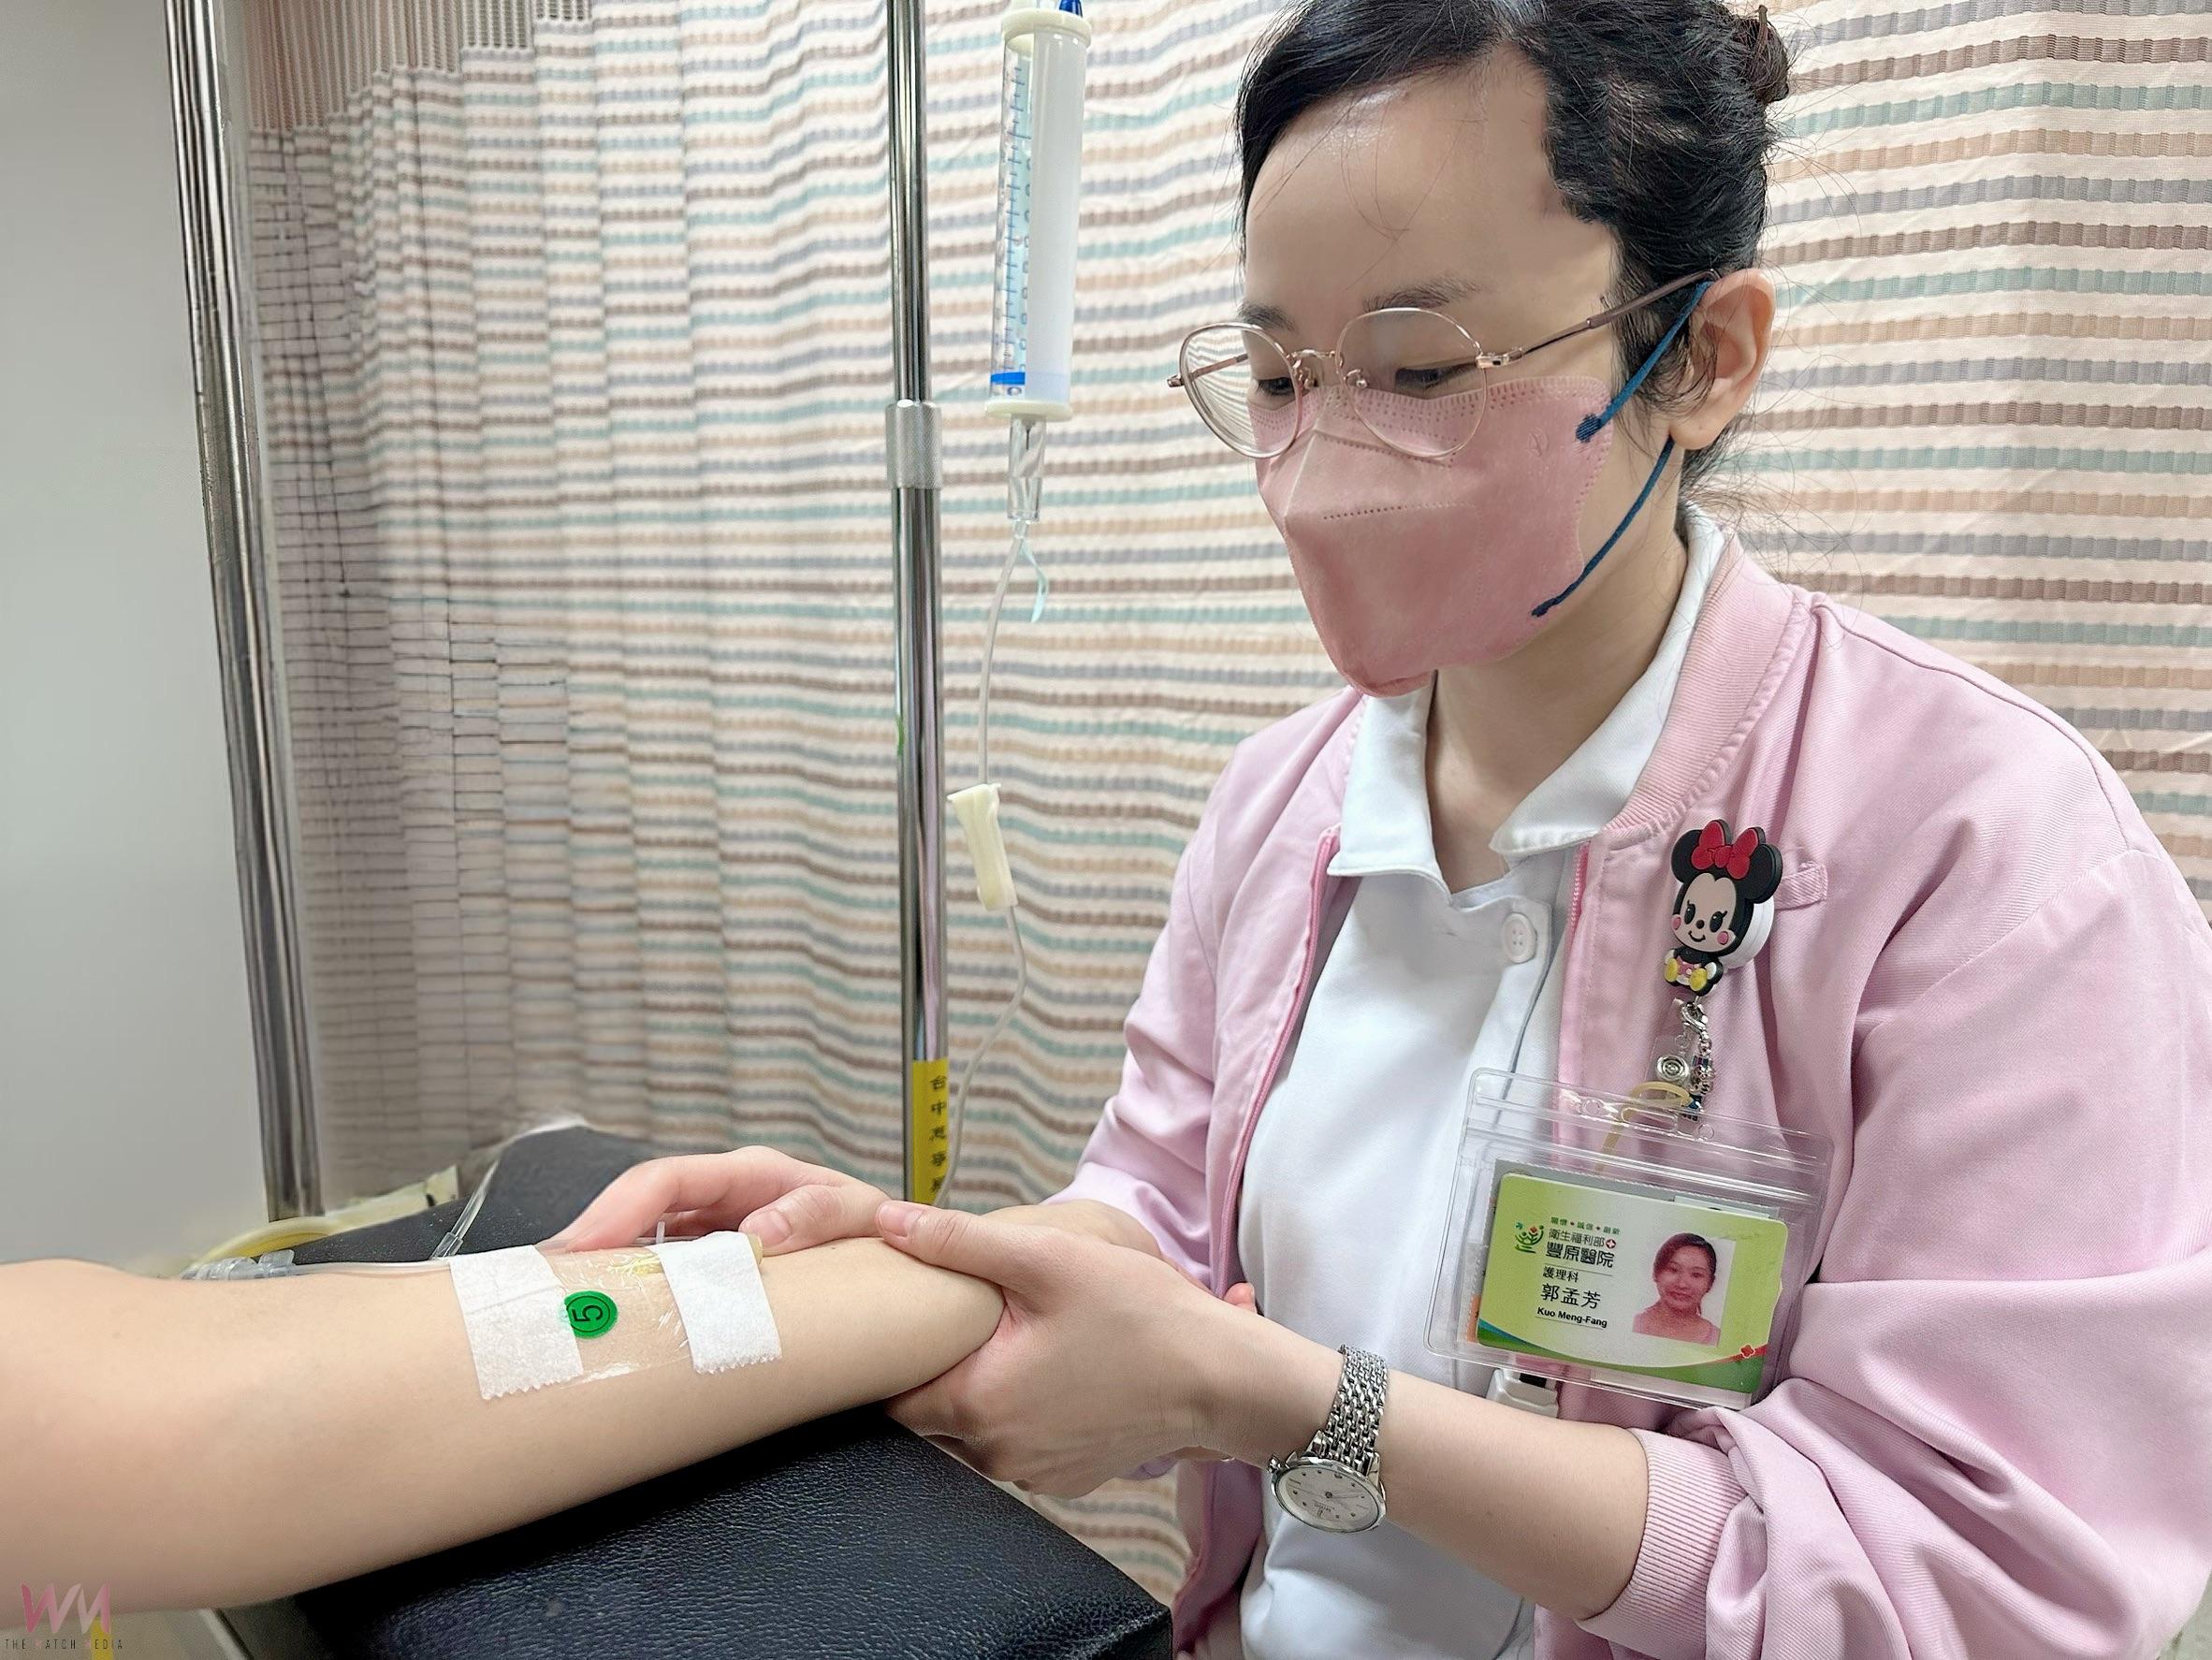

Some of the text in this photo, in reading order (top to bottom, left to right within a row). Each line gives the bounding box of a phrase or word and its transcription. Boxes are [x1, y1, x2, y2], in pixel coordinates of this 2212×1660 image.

[1549, 1228, 1606, 1248] 衛生福利部
[1546, 1242, 1615, 1268] 豐原醫院
[1542, 1265, 1579, 1283] 護理科
[1540, 1283, 1601, 1309] 郭孟芳
[571, 1304, 604, 1322] 5
[1536, 1306, 1608, 1329] Kuo Meng-Fang
